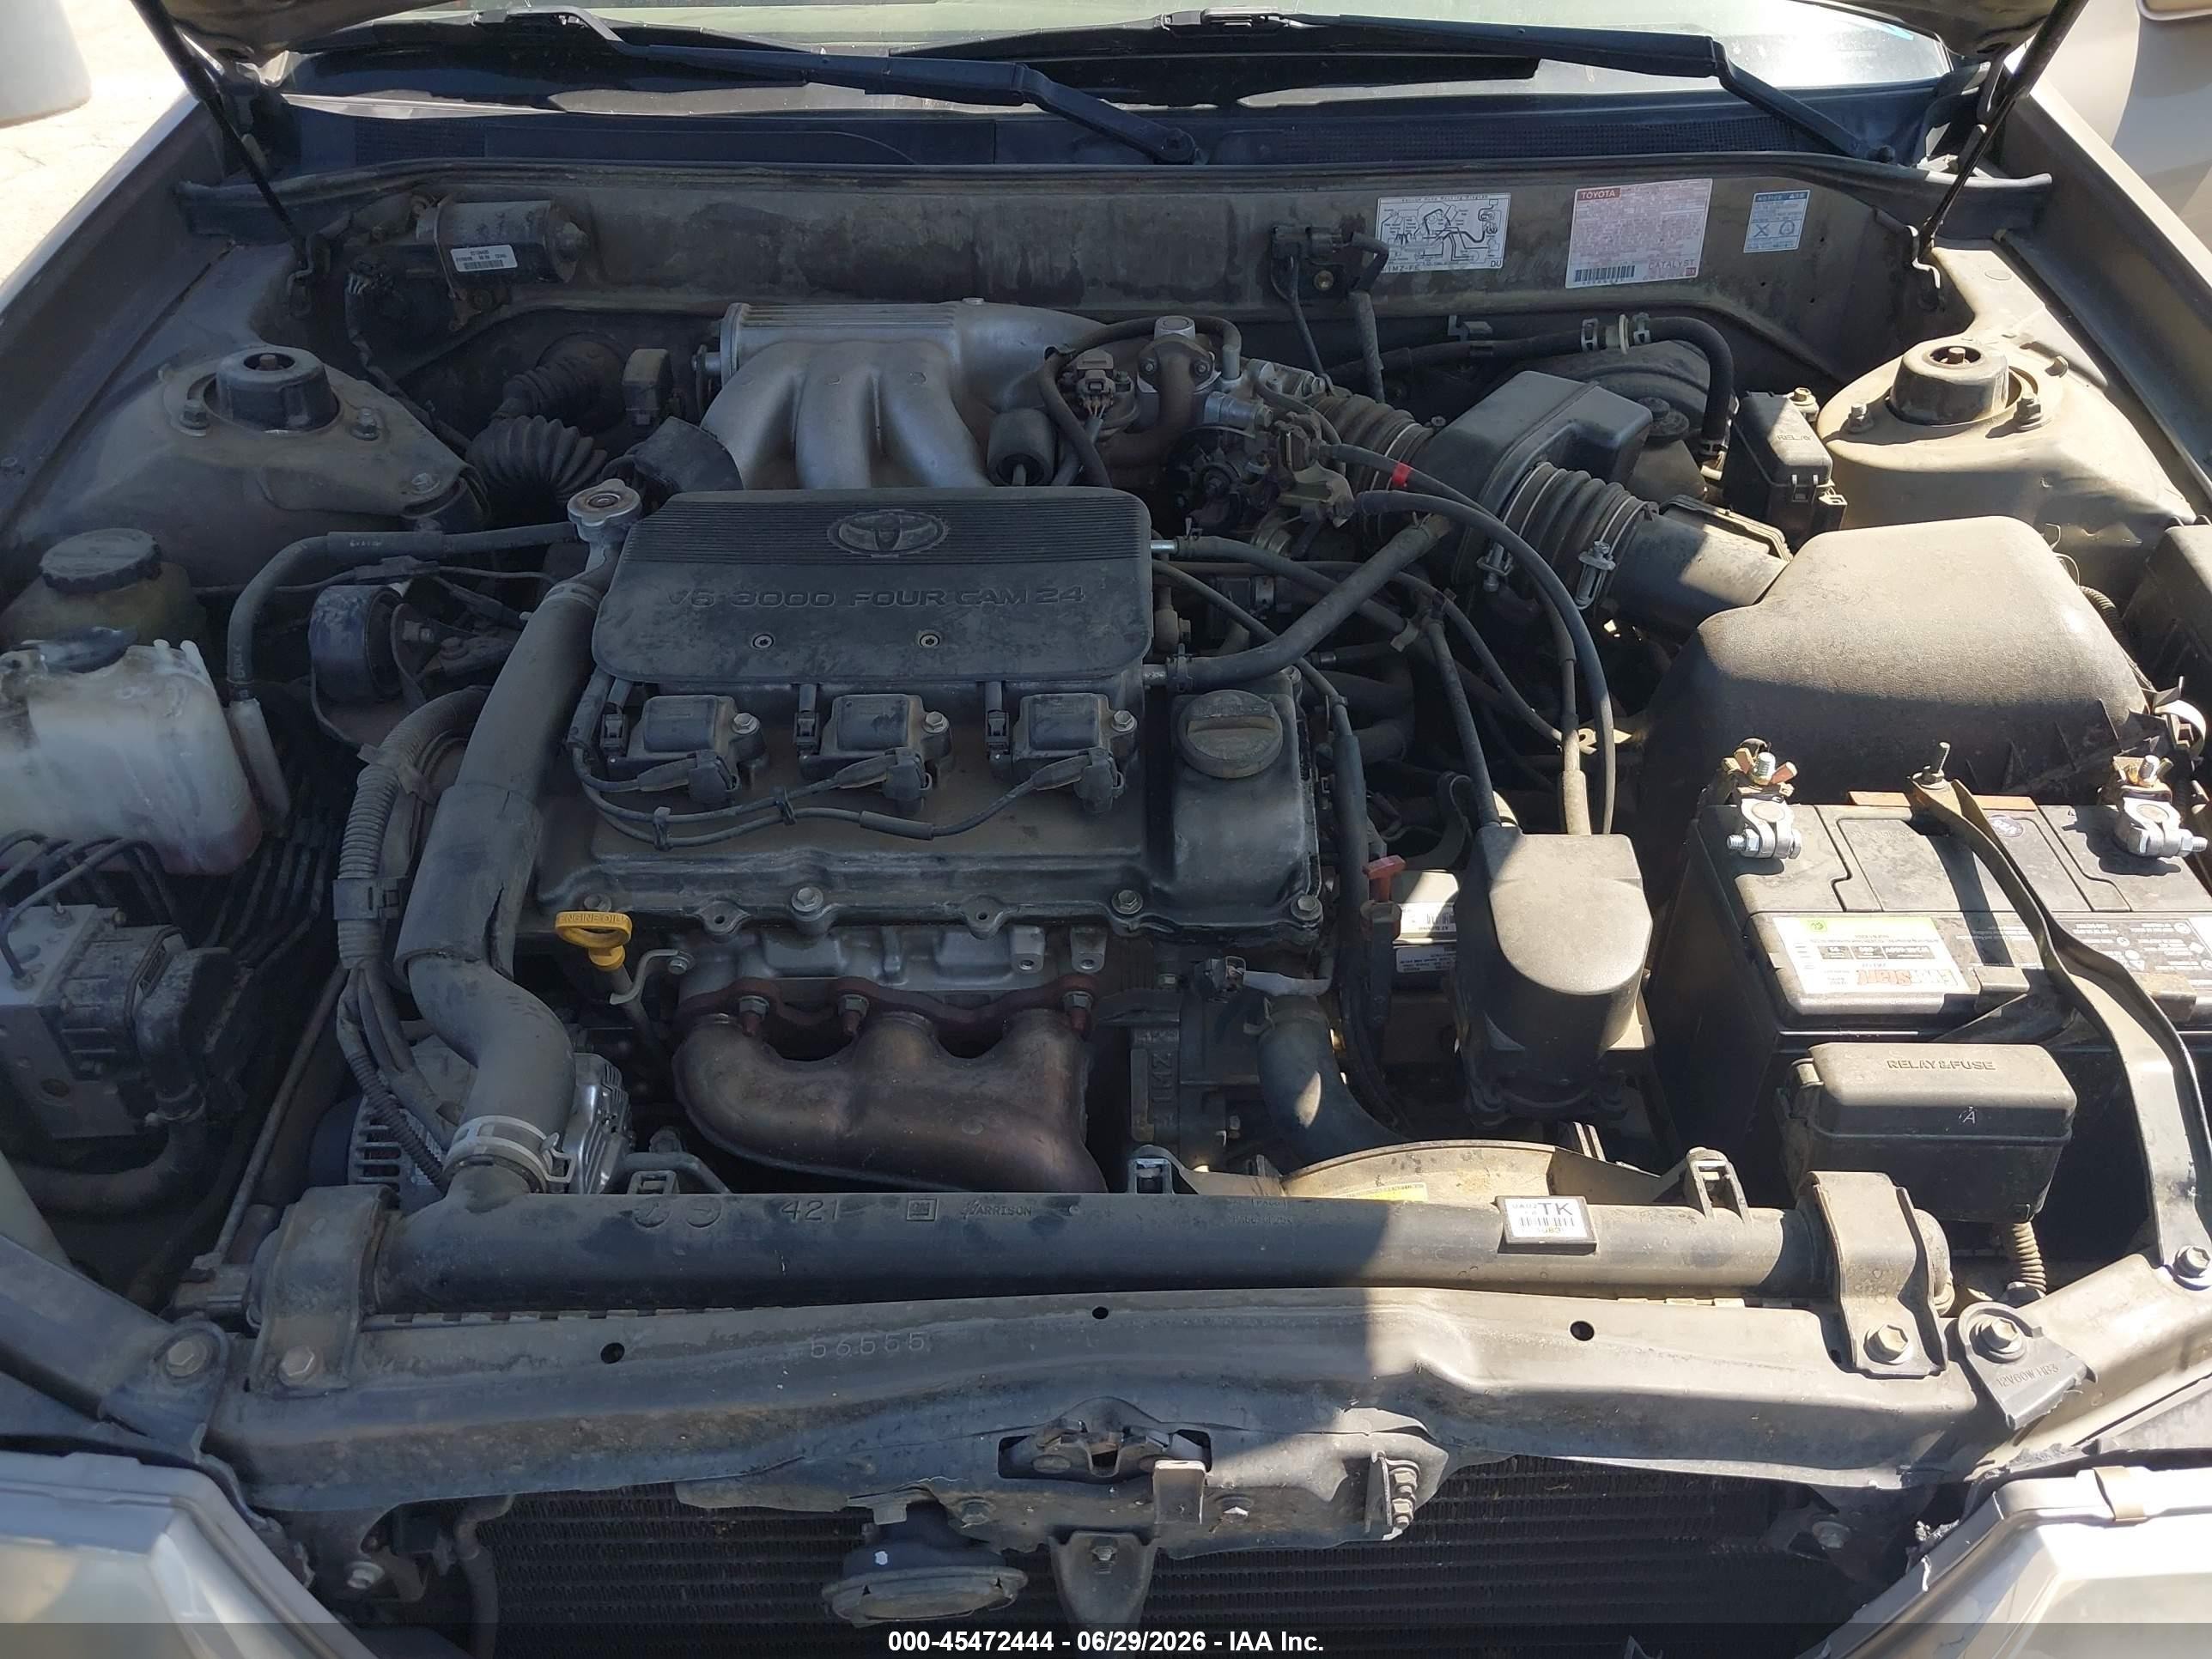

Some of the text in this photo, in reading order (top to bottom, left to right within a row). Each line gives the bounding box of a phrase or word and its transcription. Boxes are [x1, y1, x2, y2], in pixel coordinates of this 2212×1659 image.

[1581, 190, 1615, 199] TOYOTA
[1648, 259, 1695, 269] CATALYST
[668, 586, 1085, 607] V6 3000 FOUR CAM 24
[560, 913, 621, 923] ENGINE OIL
[1537, 1202, 1573, 1216] TK
[810, 1332, 926, 1358] 56555
